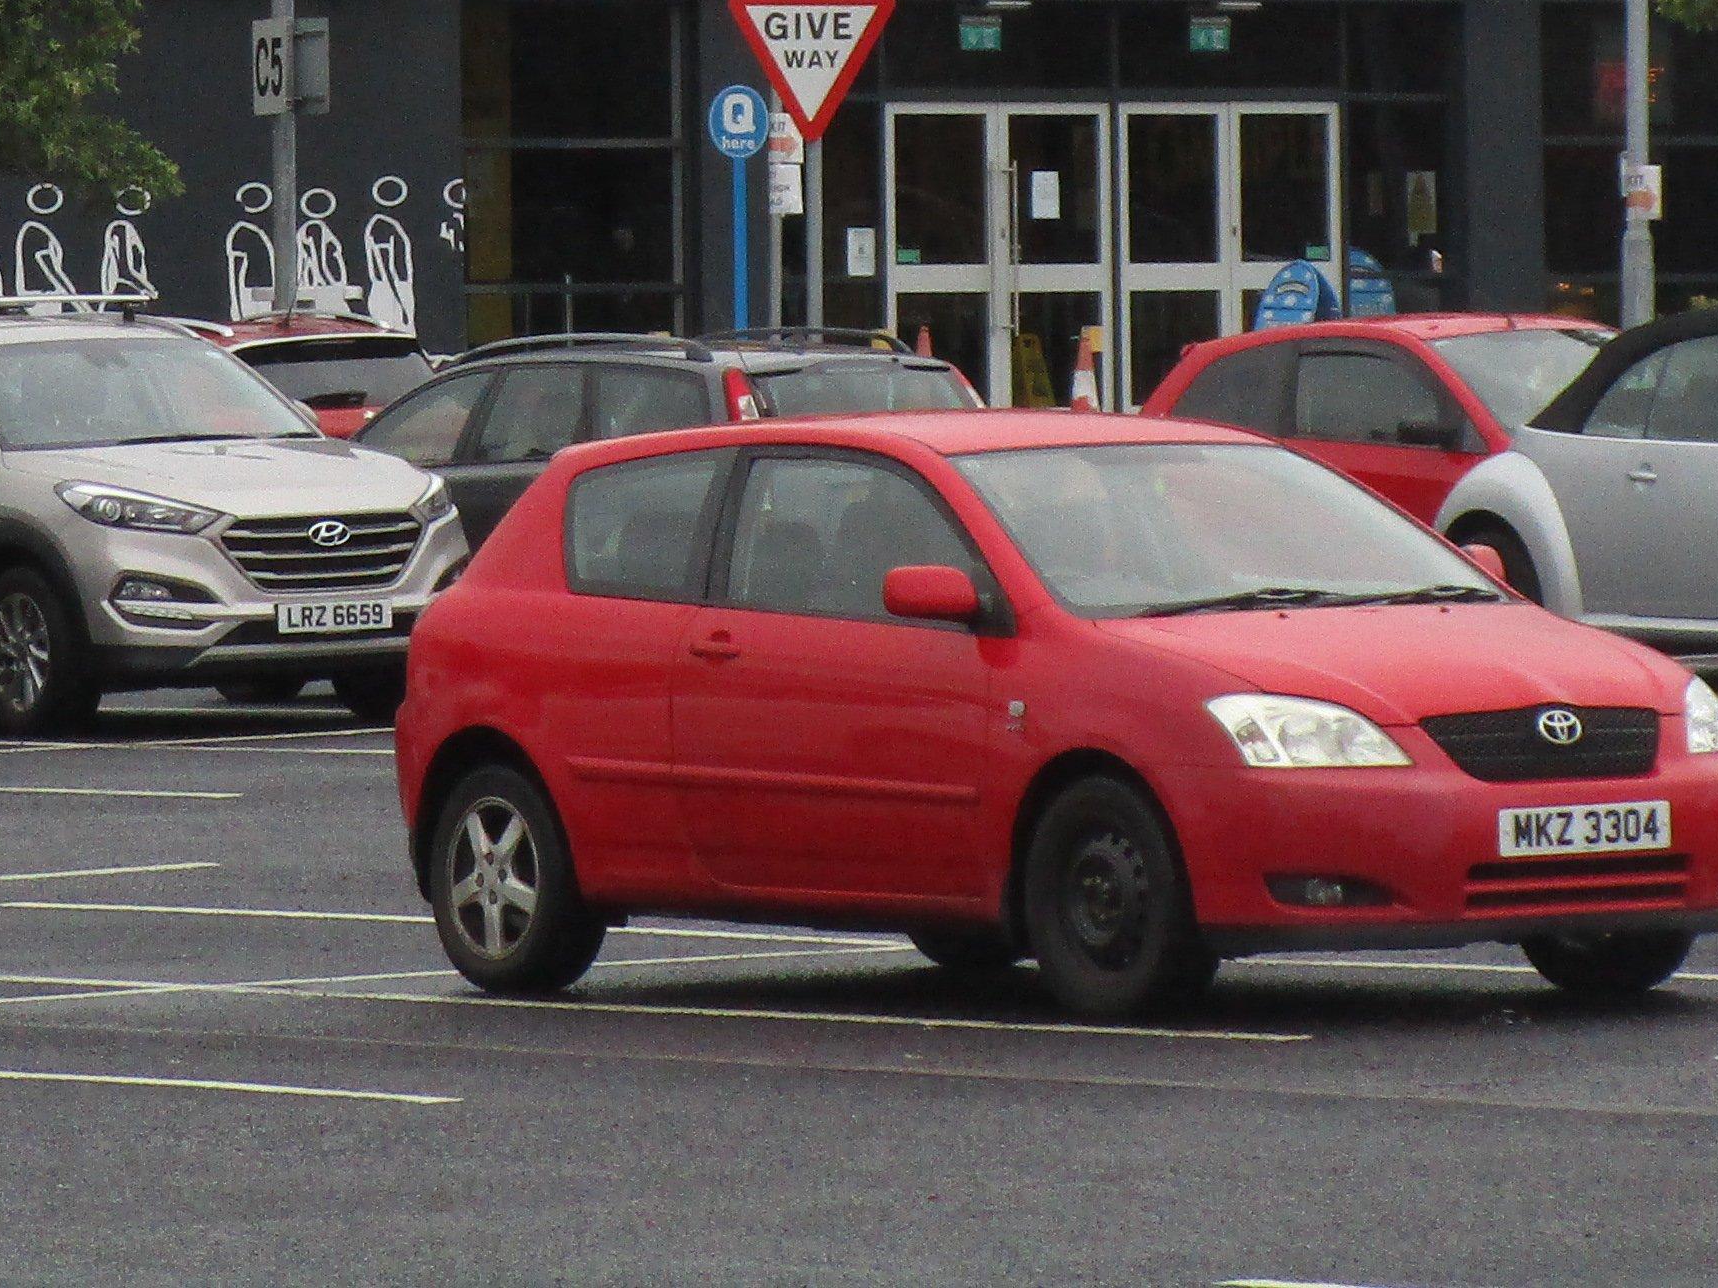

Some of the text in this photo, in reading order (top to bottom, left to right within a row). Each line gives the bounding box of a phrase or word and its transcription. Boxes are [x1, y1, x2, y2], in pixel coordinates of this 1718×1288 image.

[764, 12, 852, 40] GIVE
[256, 37, 282, 97] C5
[784, 50, 839, 69] WAY
[723, 93, 756, 134] Q
[723, 135, 755, 150] here
[287, 604, 383, 628] LRZ 6659
[1514, 808, 1660, 848] MKZ 3304
